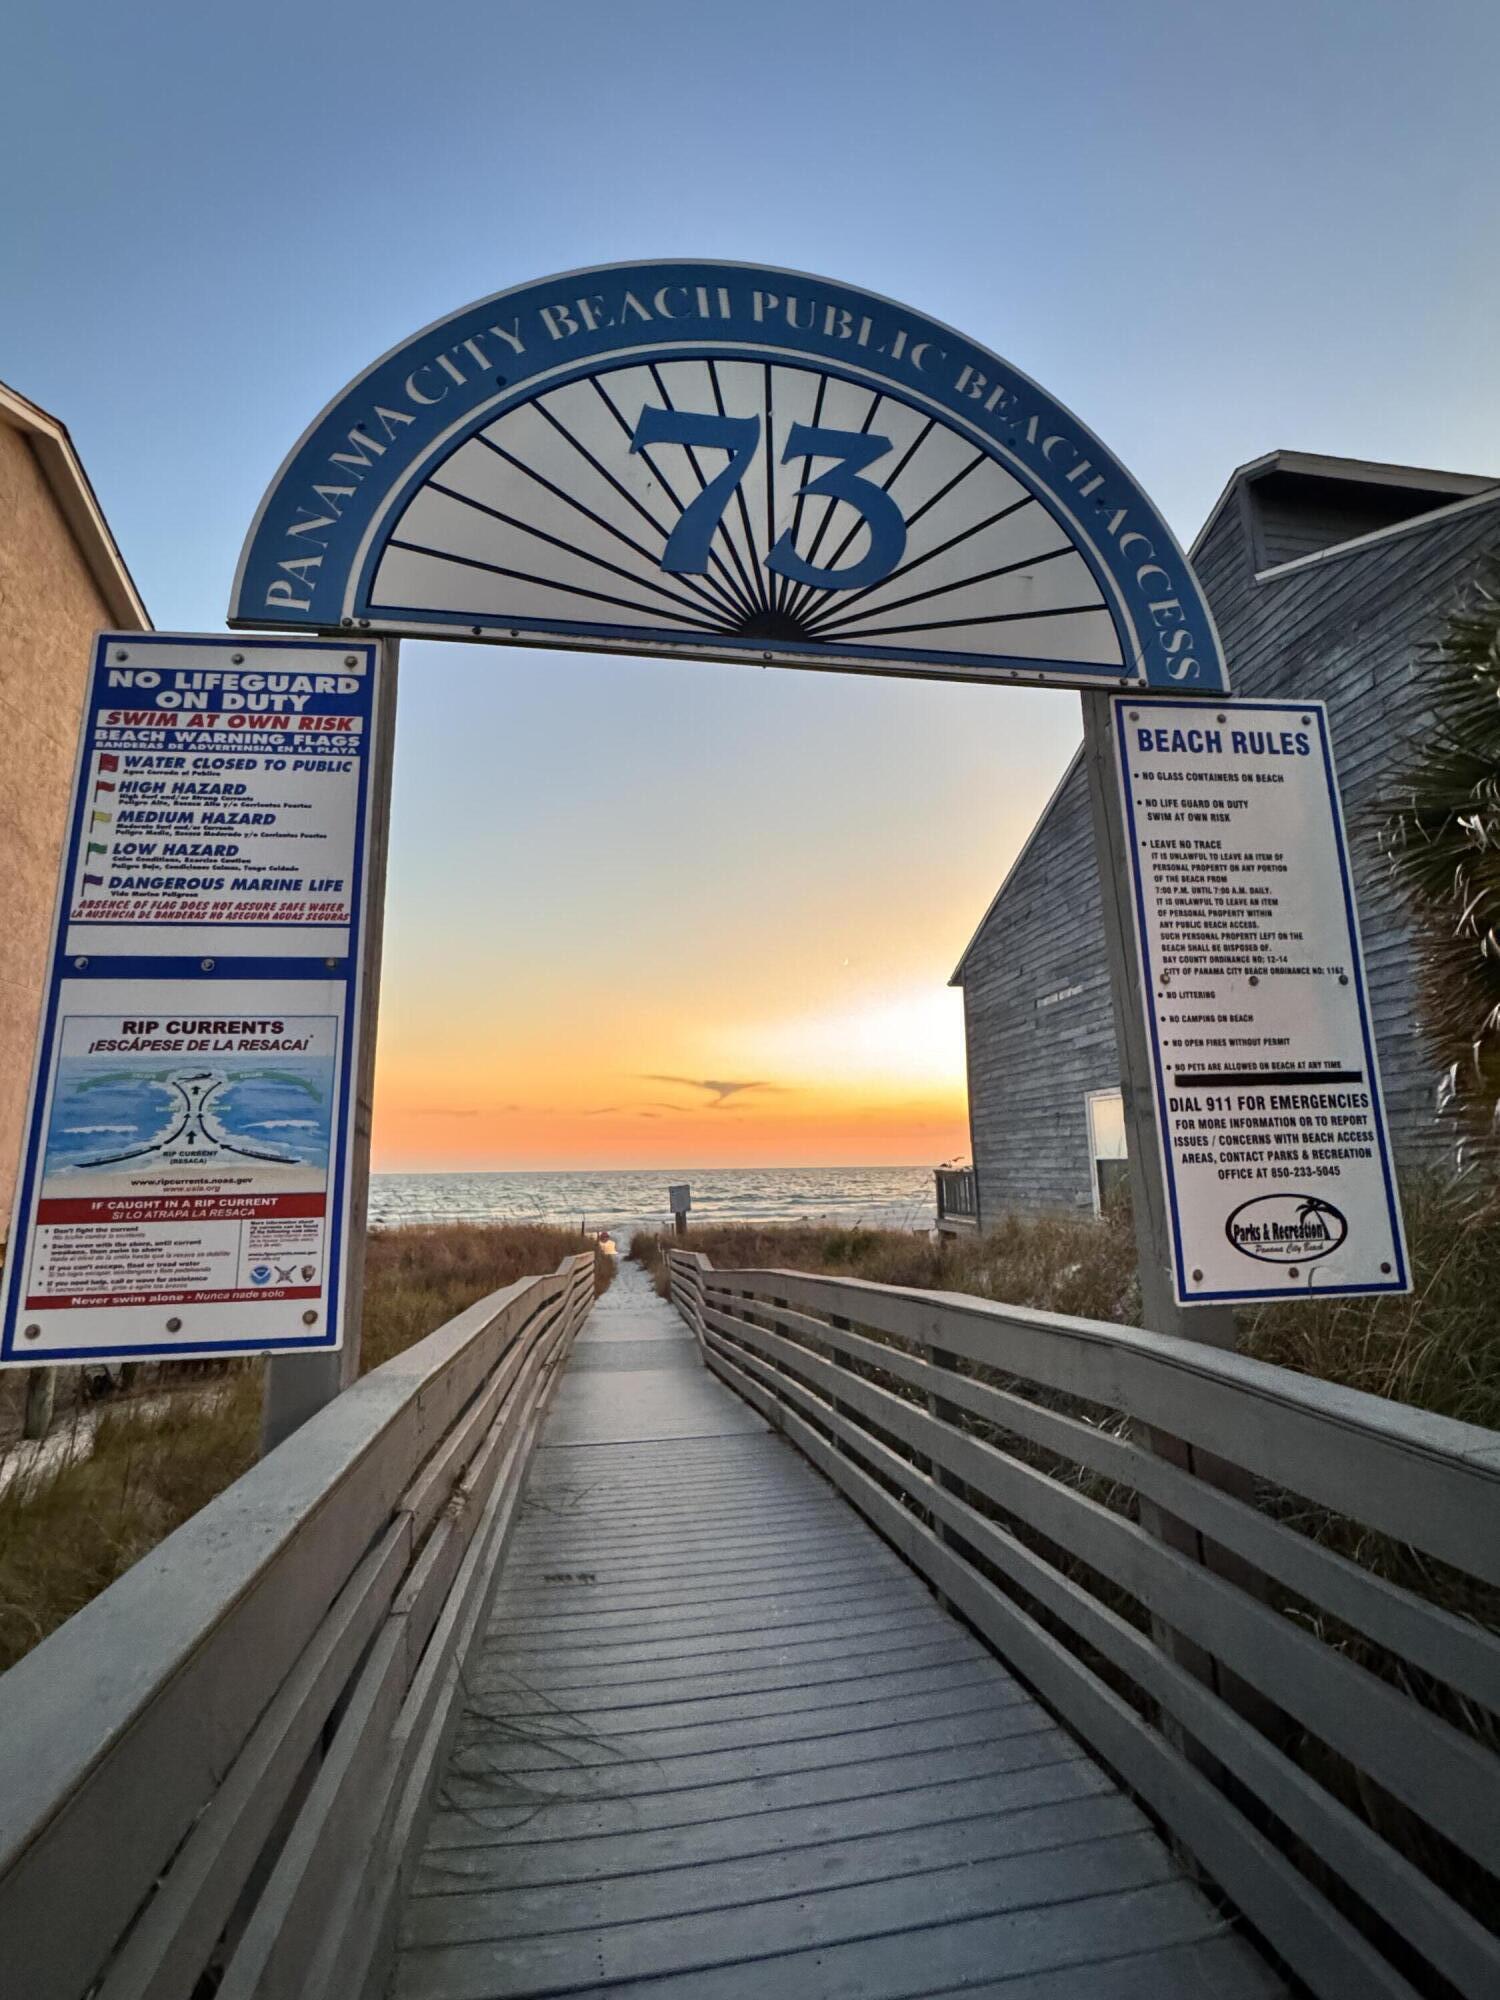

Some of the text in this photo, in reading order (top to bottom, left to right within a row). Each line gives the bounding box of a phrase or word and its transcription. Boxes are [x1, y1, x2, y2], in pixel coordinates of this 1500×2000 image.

[265, 286, 1200, 681] PANAMA CITY BEACH PUBLIC BEACH ACCESS
[629, 403, 907, 591] 73
[108, 671, 359, 694] NO LIFEGUARD
[155, 691, 310, 712] ON DUTY
[106, 712, 352, 731] SWIM AT OWN RISK
[94, 729, 359, 747] BEACH WARNING FLAGS
[1137, 728, 1309, 756] BEACH RULES
[95, 741, 163, 750] BANDERAS
[276, 745, 294, 753] EN
[316, 746, 356, 755] PLAYA
[125, 755, 352, 773] WATER CLOSED TO PUBLIC
[1142, 772, 1283, 783] NO GLASS CONTAINERS ON BEACH
[118, 782, 246, 795] HIGH HAZARD
[1145, 799, 1247, 809] NO LIFE GUARD ON DUTY
[117, 811, 275, 825] MEDIUM HAZARD
[1147, 813, 1230, 822] SWIM AT OWN RISK
[112, 843, 238, 857] LOW HAZARD
[1150, 840, 1221, 849] LEAVE NO TRACE
[109, 877, 343, 892] DANGEROUS MARINE LIFE
[78, 900, 344, 912] ABSENCE OF FLAG DOES NOT ASSURE SAFE WATER
[70, 910, 350, 921] LA AUSENCIA DE BANDERAS NO ASEGURA AGUAS SEGURAS
[1169, 1015, 1253, 1023] NO CAMPING ON BEACH
[122, 1021, 283, 1035] RIP CURRENTS
[186, 1038, 210, 1053] DE
[212, 1039, 233, 1052] LA
[1172, 1038, 1289, 1047] NO OPEN FIRES WITHOUT PERMIT
[1175, 1061, 1341, 1072] NO PETS ARE ALLOWED ON BEACH AT ANY TIME
[1169, 1093, 1368, 1113] DIAL 911 FOR EMERGENCIES
[1175, 1115, 1366, 1130] FOR MORE INFORMATION OR TO REPORT
[1174, 1136, 1208, 1147] ISSUES
[1219, 1134, 1270, 1146] CONCERNS
[1274, 1133, 1299, 1144] WITH
[1302, 1132, 1333, 1144] BEACH
[1337, 1131, 1373, 1143] ACCESS
[1182, 1153, 1217, 1164] AREAS,
[1219, 1151, 1263, 1163] CONTACT
[1267, 1150, 1298, 1161] PARKS
[1312, 1148, 1371, 1160] RECREATION
[1218, 1166, 1340, 1180] OFFICE AT 850-233-5045
[92, 1198, 276, 1211] IF CAUGHT IN A RIP CURRENT
[112, 1209, 254, 1219] SI LO ATRAPA LA RESACA
[1233, 1223, 1261, 1242] Parks
[1271, 1222, 1324, 1240] Recreation
[71, 1295, 108, 1305] Never
[112, 1294, 145, 1304] swim
[149, 1293, 183, 1303] alone
[195, 1291, 229, 1301] Nunca
[232, 1290, 258, 1300] nade
[261, 1289, 284, 1299] solo
